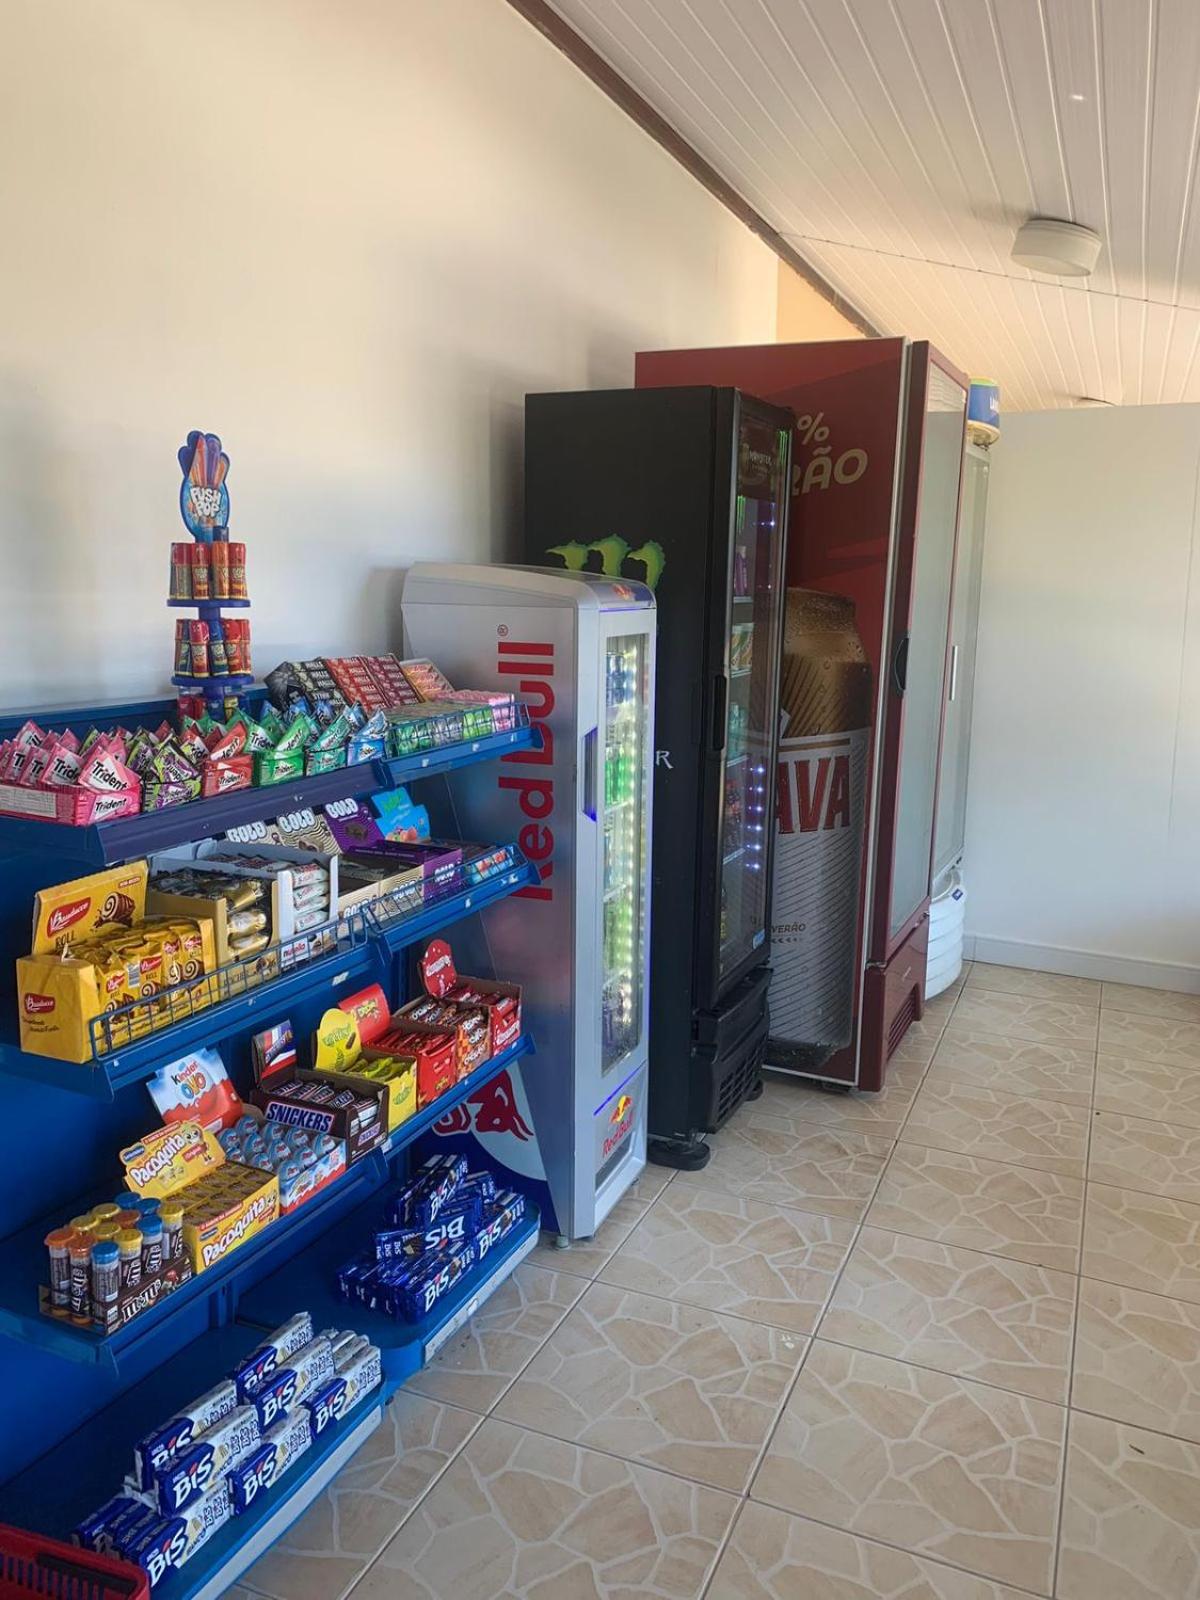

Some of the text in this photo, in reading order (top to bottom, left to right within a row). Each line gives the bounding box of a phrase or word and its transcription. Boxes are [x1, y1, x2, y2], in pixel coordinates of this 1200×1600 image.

[190, 487, 221, 505] PUSH
[196, 501, 219, 517] POP
[92, 761, 127, 790] Trident
[95, 798, 127, 812] Trident
[325, 798, 359, 819] BOLD
[279, 809, 315, 833] BOLD
[227, 821, 267, 843] BOLD
[56, 930, 76, 947] ROLL
[171, 1061, 198, 1085] Kinder
[267, 1103, 333, 1133] SNICKERS
